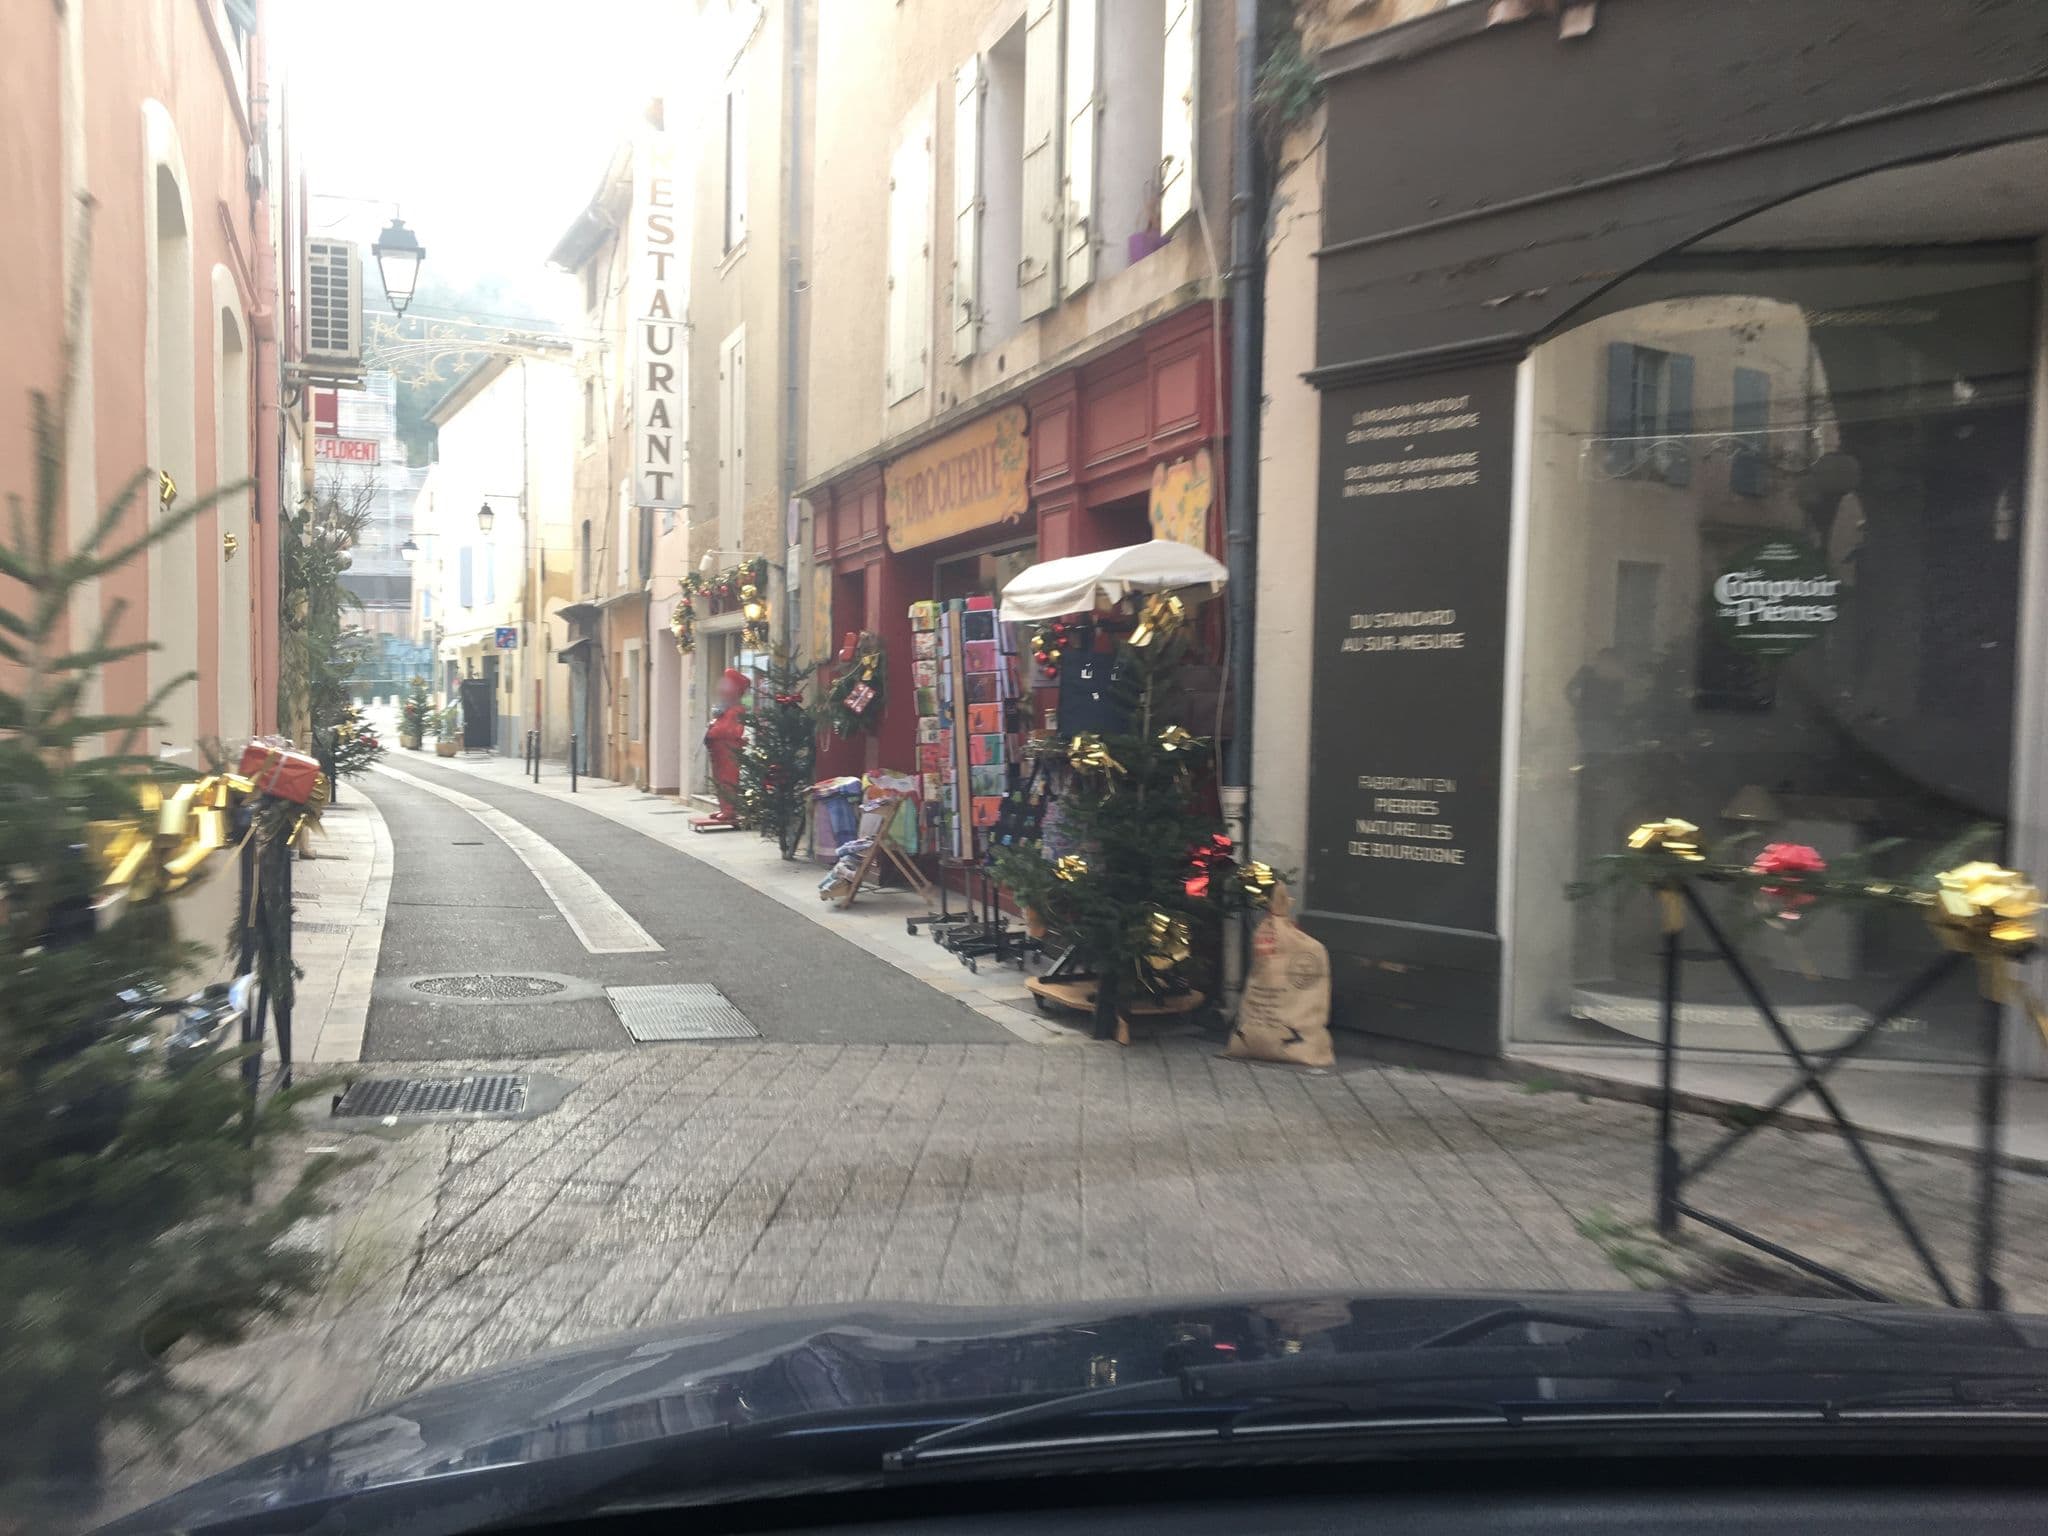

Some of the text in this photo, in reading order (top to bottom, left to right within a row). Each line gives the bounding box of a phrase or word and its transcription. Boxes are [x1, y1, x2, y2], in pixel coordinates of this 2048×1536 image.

[1429, 412, 1480, 432] EUROPE
[326, 440, 377, 460] FLORENT
[1429, 470, 1480, 489] EUROPE
[1350, 609, 1457, 629] DU STANDARD
[1341, 632, 1466, 652] AU SUR-MESURE
[1358, 775, 1457, 792] FABRICANT EN
[1374, 797, 1440, 816] PIERRES
[1355, 819, 1454, 840] NATURELLES
[1348, 840, 1467, 865] DE BOURGOGNE
